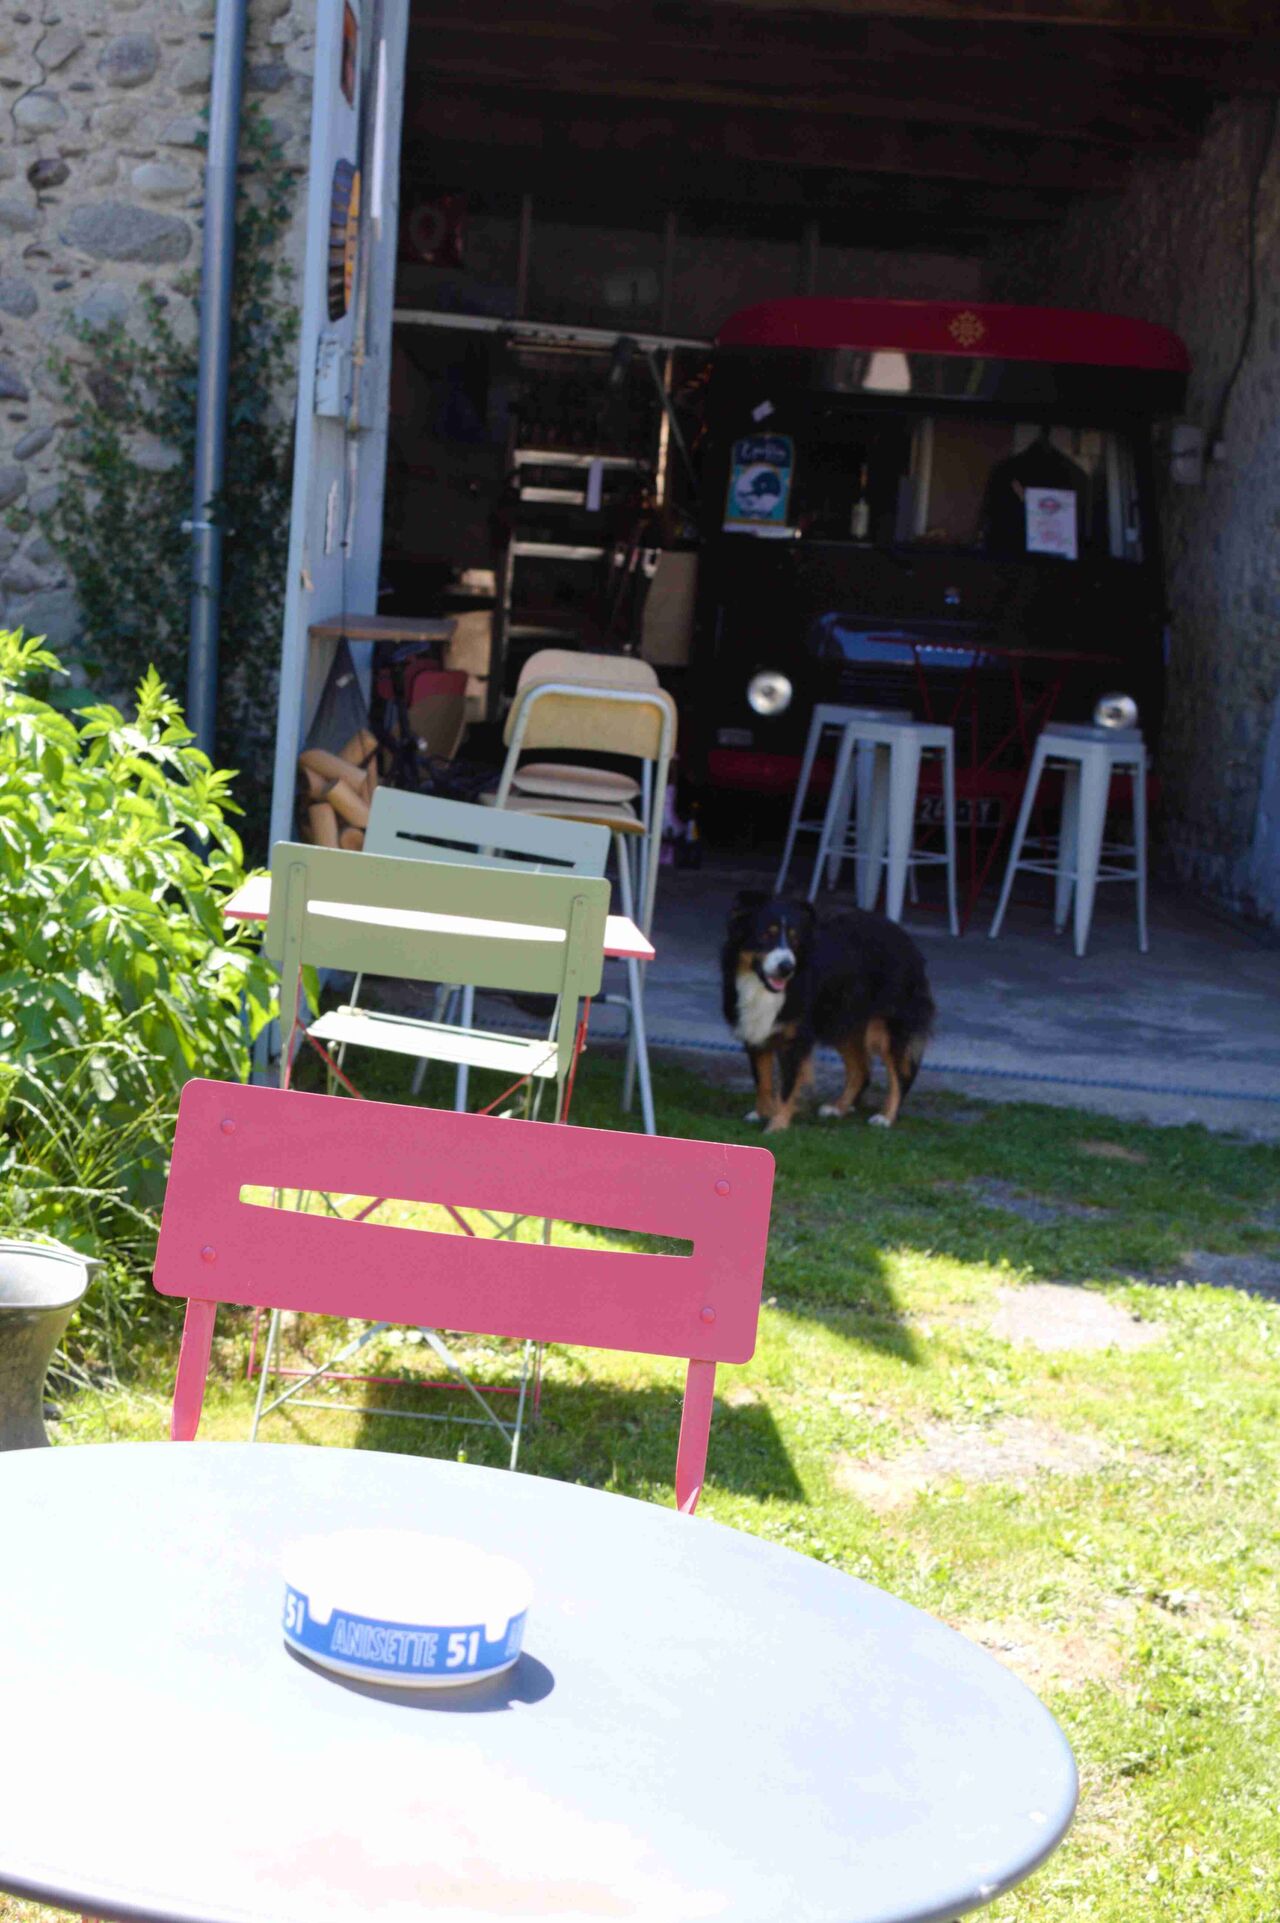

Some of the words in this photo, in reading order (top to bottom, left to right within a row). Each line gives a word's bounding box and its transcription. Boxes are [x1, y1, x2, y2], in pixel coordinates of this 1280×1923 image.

[285, 1593, 305, 1635] 51
[331, 1618, 438, 1668] ANISETTE
[446, 1631, 480, 1668] 51
